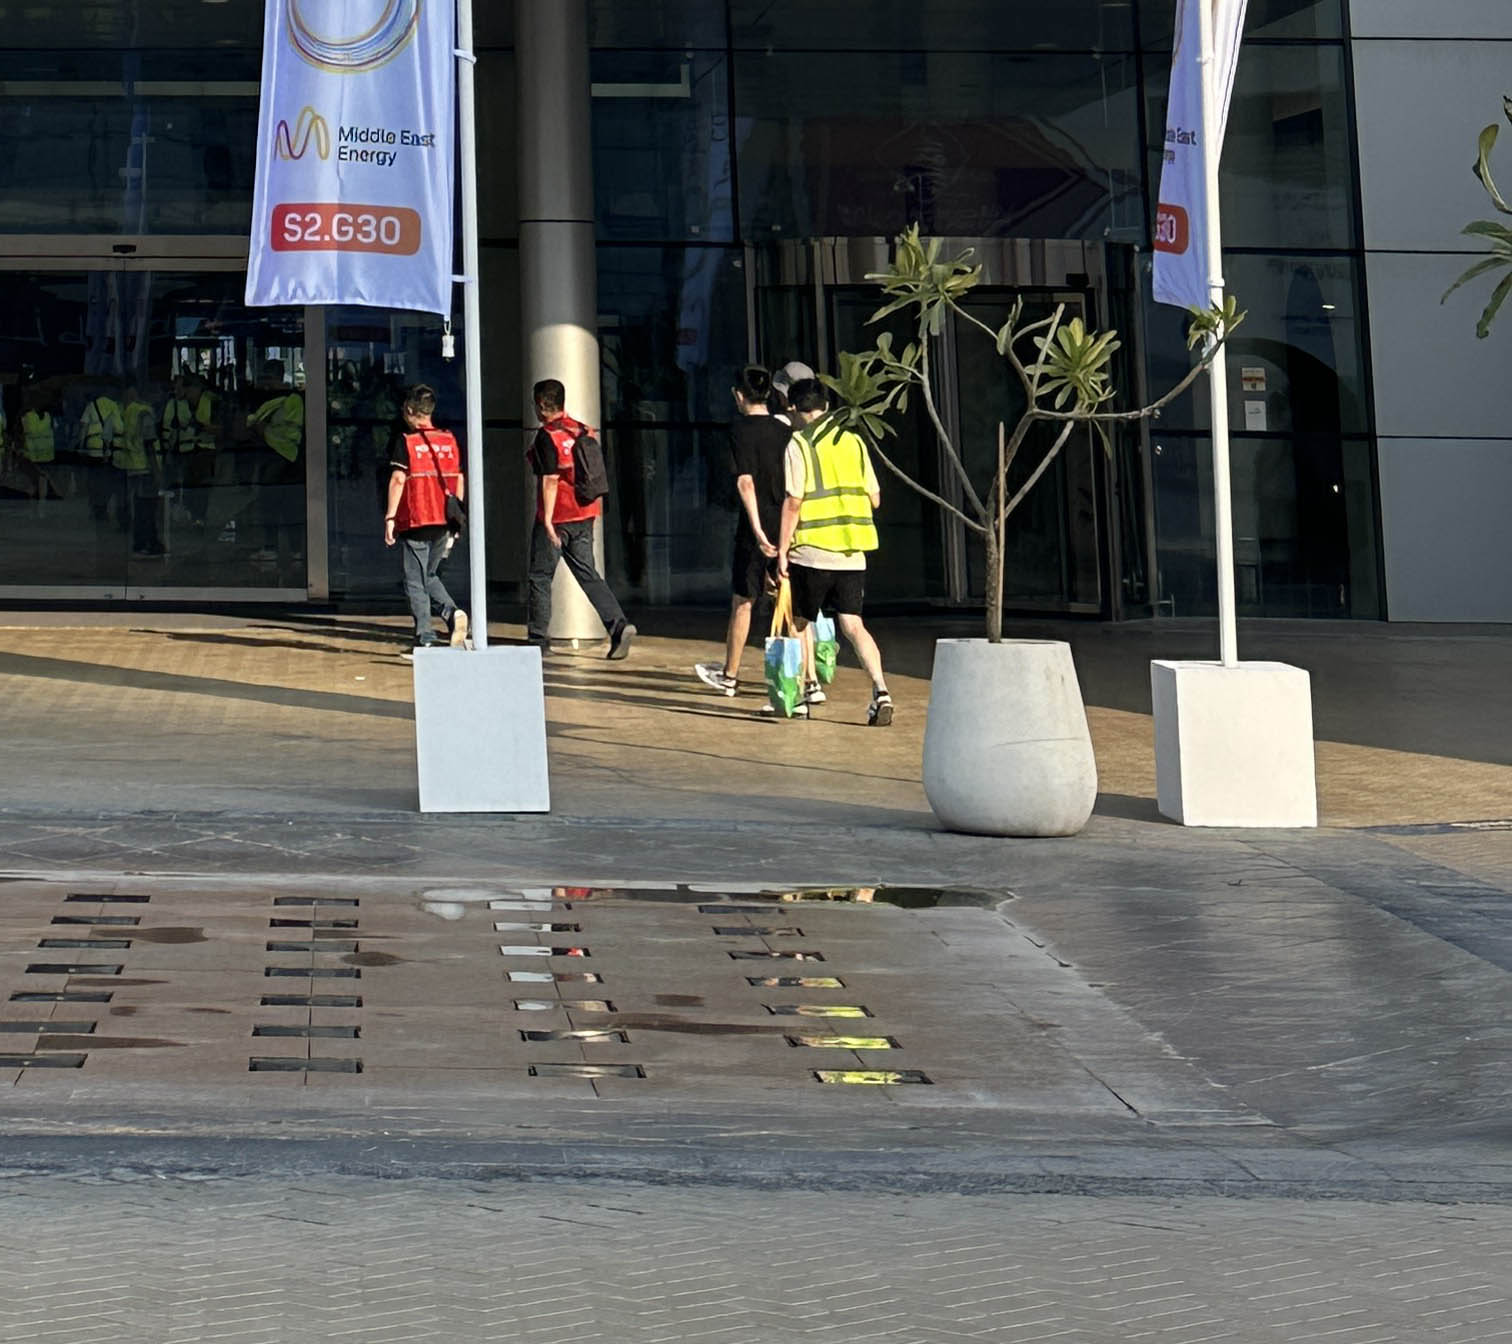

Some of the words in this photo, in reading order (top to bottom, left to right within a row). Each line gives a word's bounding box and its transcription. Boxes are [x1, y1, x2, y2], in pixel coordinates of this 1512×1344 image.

[338, 126, 397, 145] Middle
[400, 130, 436, 148] East
[337, 146, 397, 167] Energy
[283, 212, 401, 246] S2.G30
